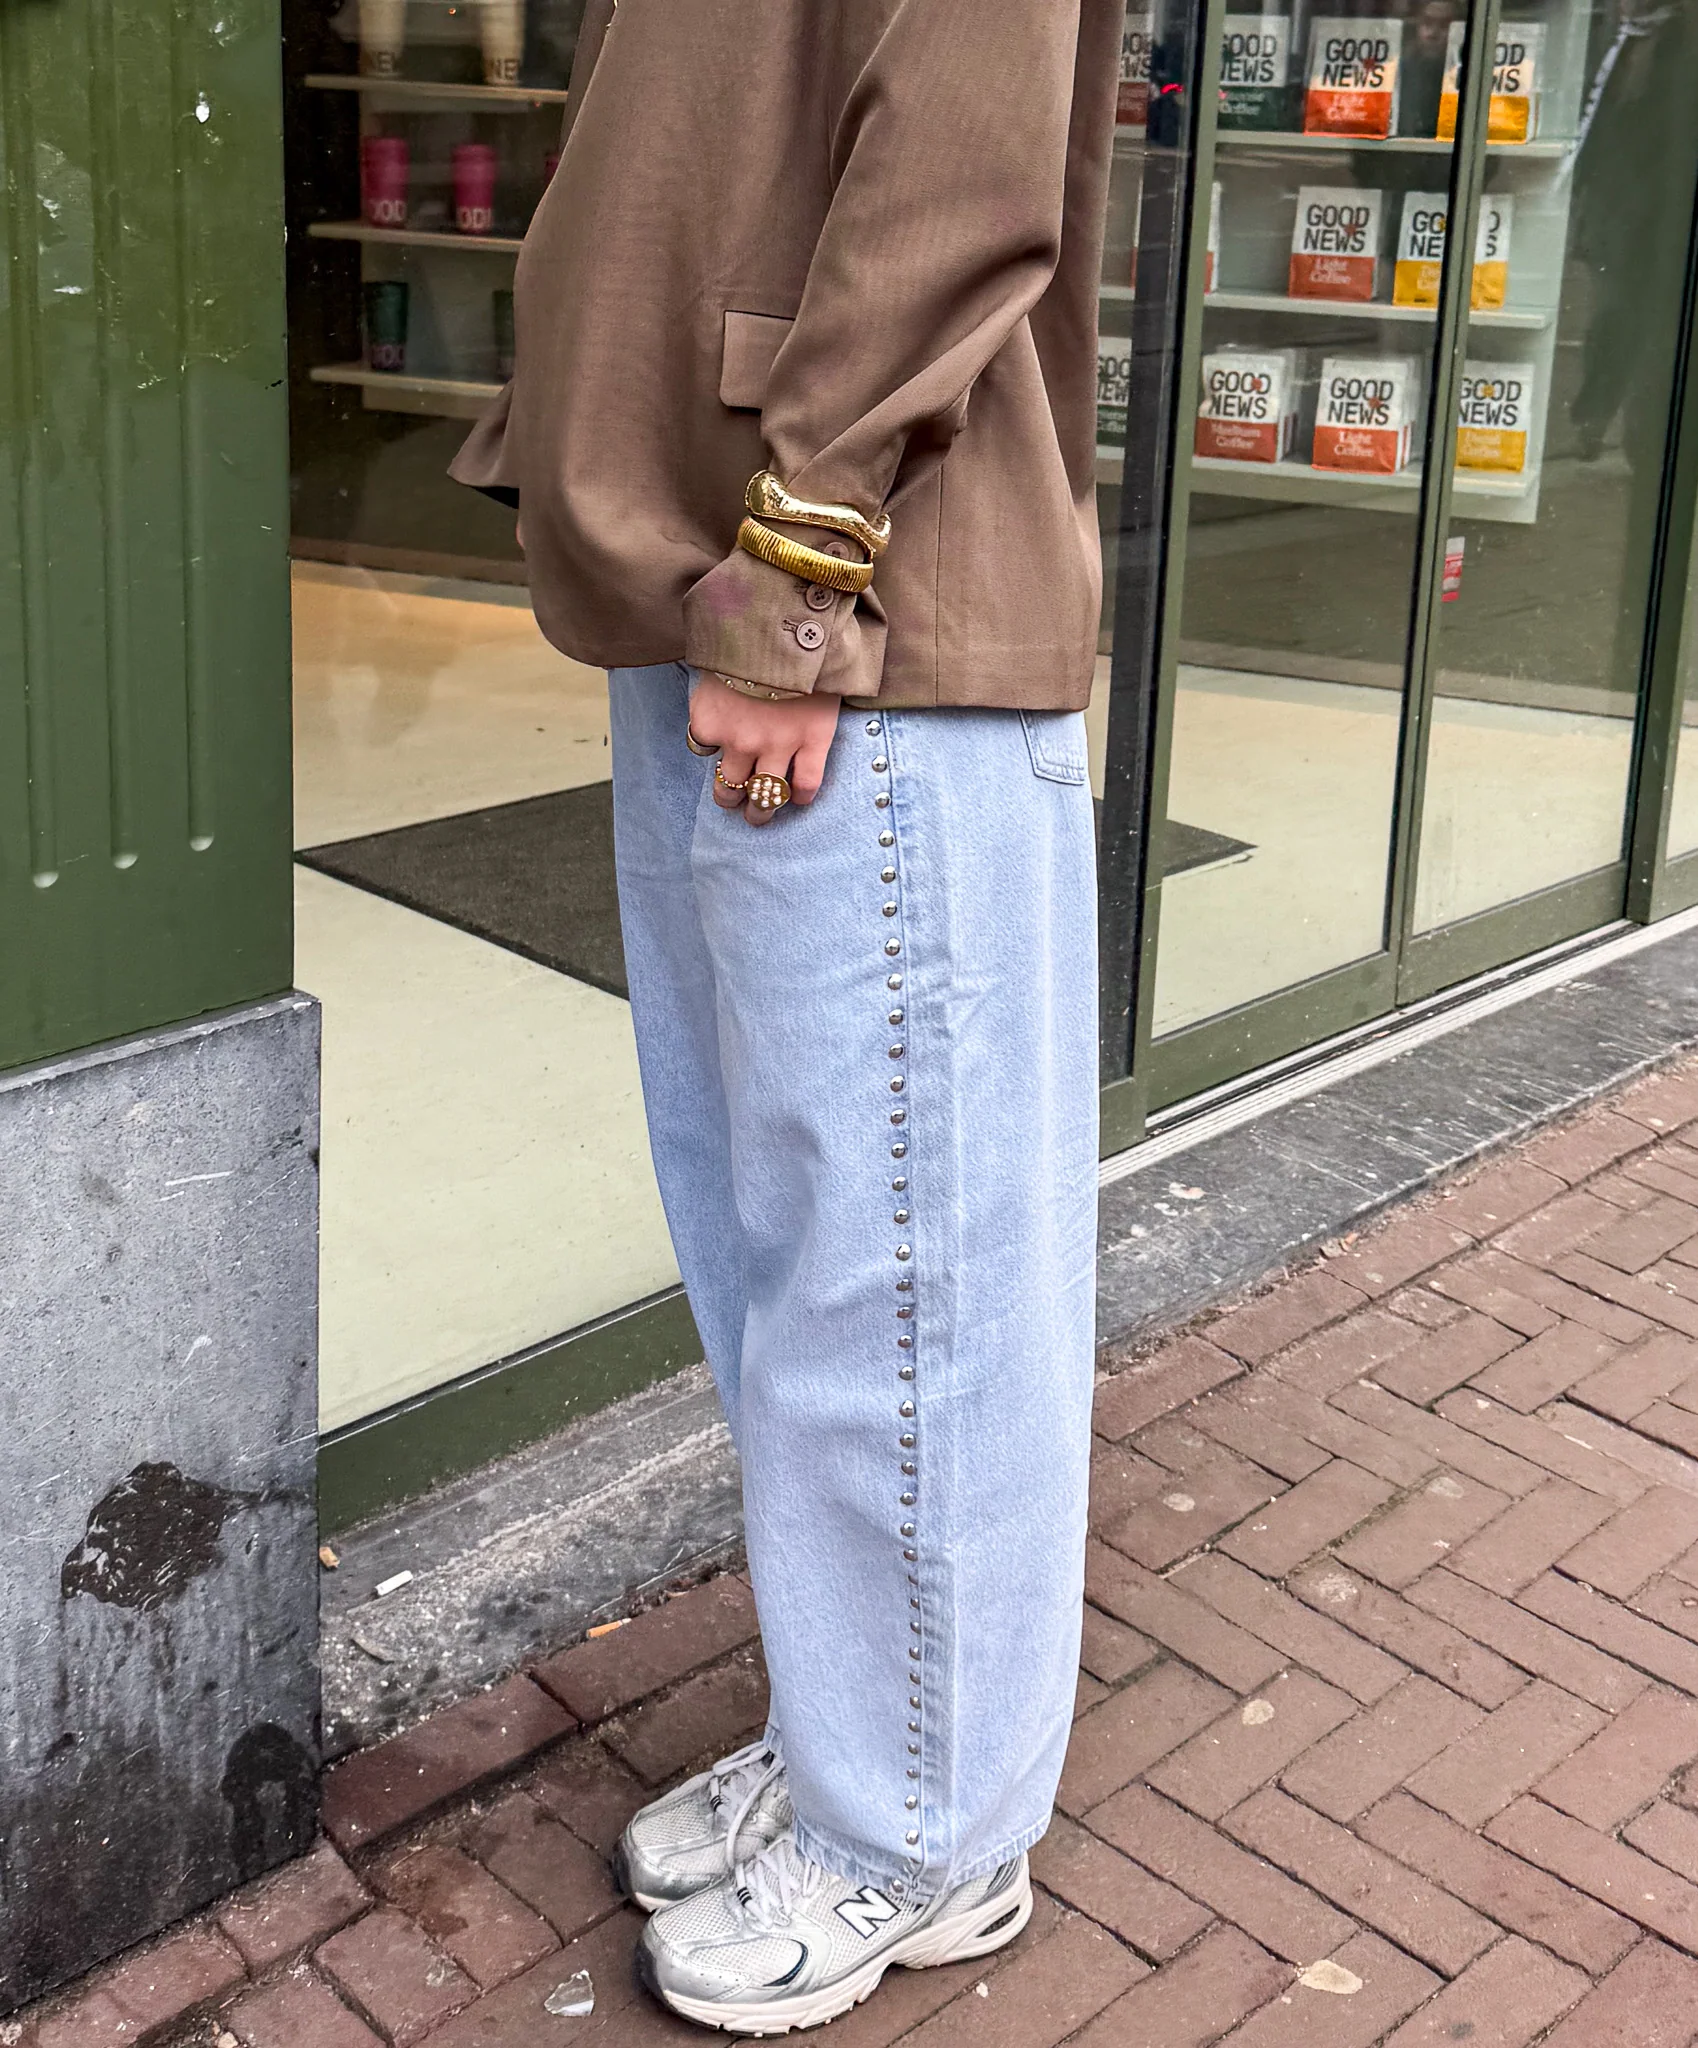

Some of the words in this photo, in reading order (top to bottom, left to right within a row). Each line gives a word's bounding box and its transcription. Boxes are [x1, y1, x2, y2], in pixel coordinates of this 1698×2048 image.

[1325, 38, 1390, 62] GOOD
[1494, 42, 1525, 66] OD
[1321, 63, 1386, 88] NEWS
[1306, 204, 1370, 228] GOOD
[1412, 211, 1446, 234] GO
[1303, 228, 1366, 252] NEWS
[1409, 234, 1445, 257] NE
[1210, 370, 1272, 395] GOOD
[1330, 377, 1394, 402] GOOD
[1208, 394, 1268, 419] NEWS
[1327, 401, 1391, 426] NEWS
[833, 1885, 901, 1939] N
